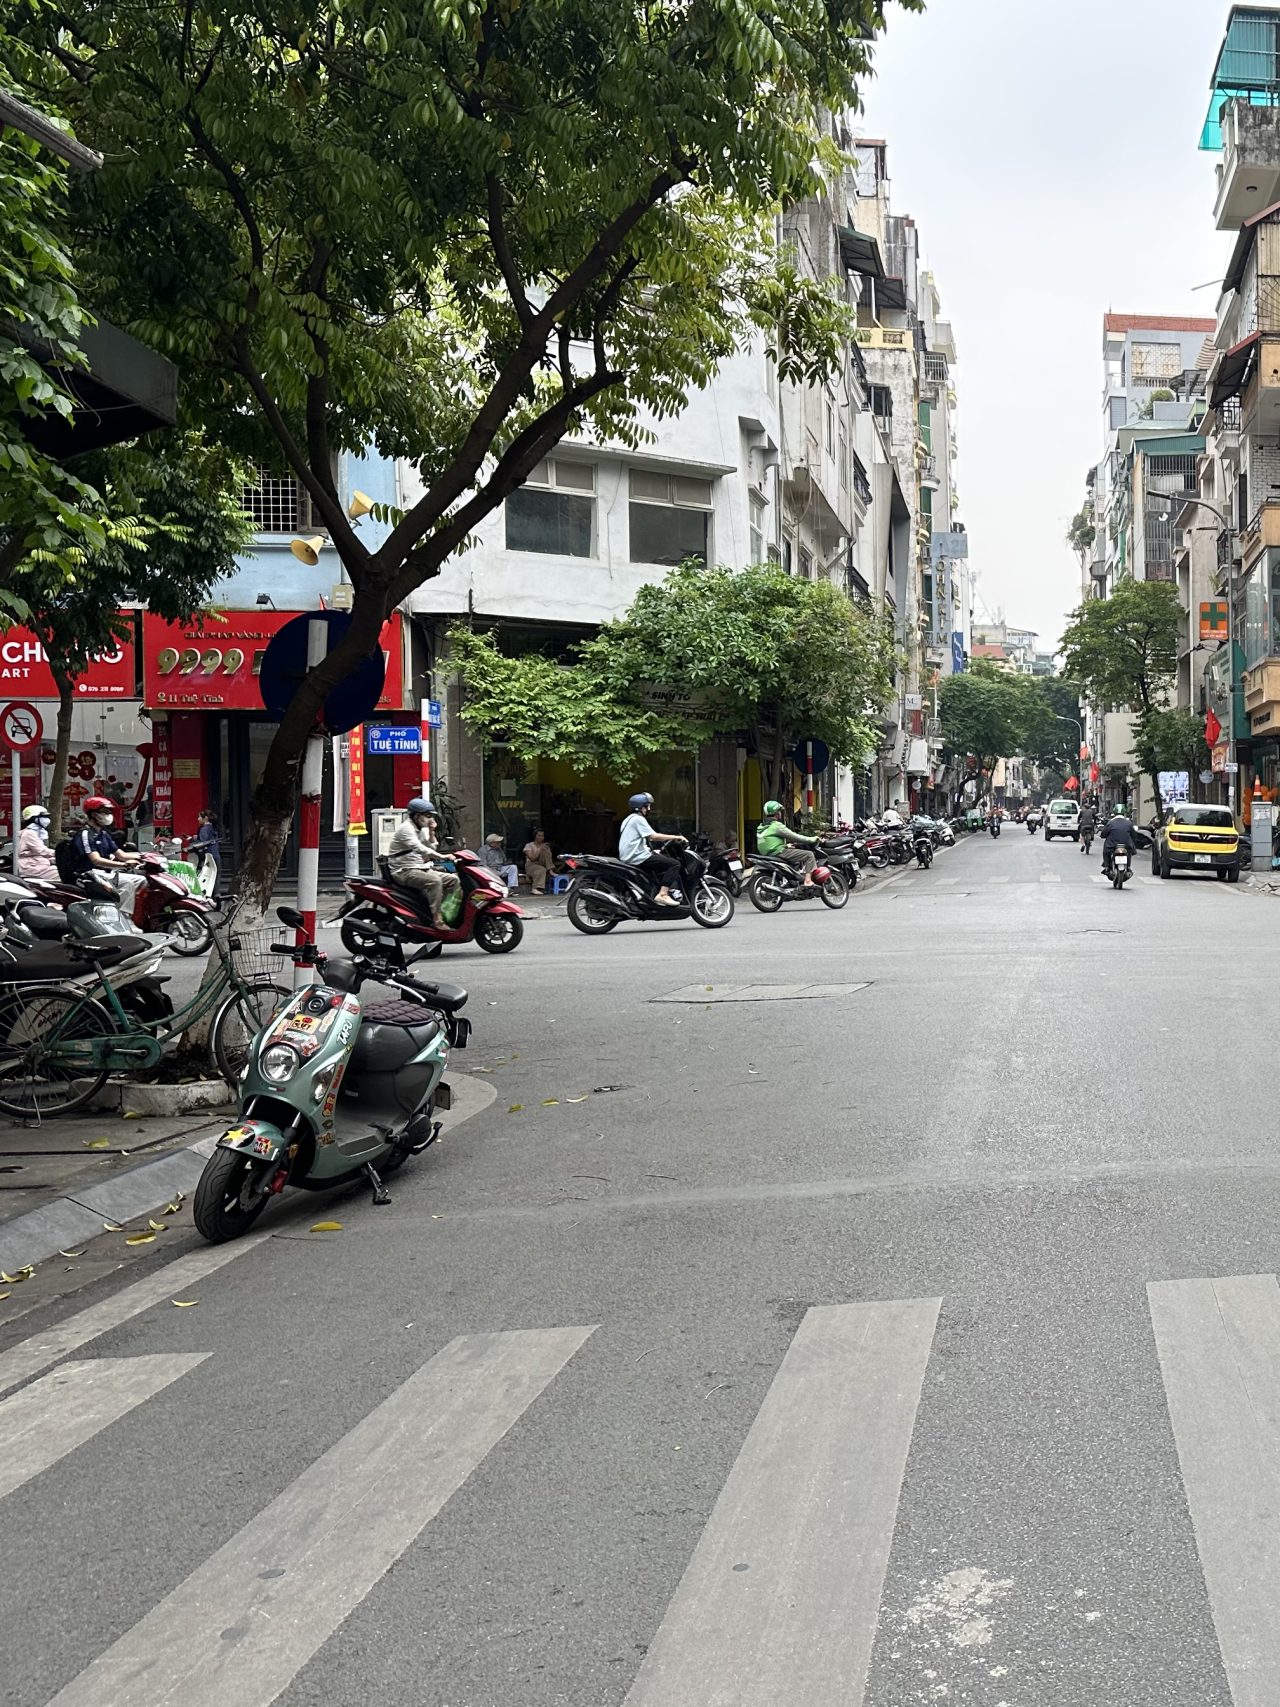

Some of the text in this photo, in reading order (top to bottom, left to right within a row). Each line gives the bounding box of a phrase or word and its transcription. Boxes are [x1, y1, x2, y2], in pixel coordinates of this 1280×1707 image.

[157, 647, 245, 675] 9999
[2, 668, 31, 678] ART
[389, 729, 407, 737] PHỐ
[373, 738, 418, 752] TUỆ TĨNH
